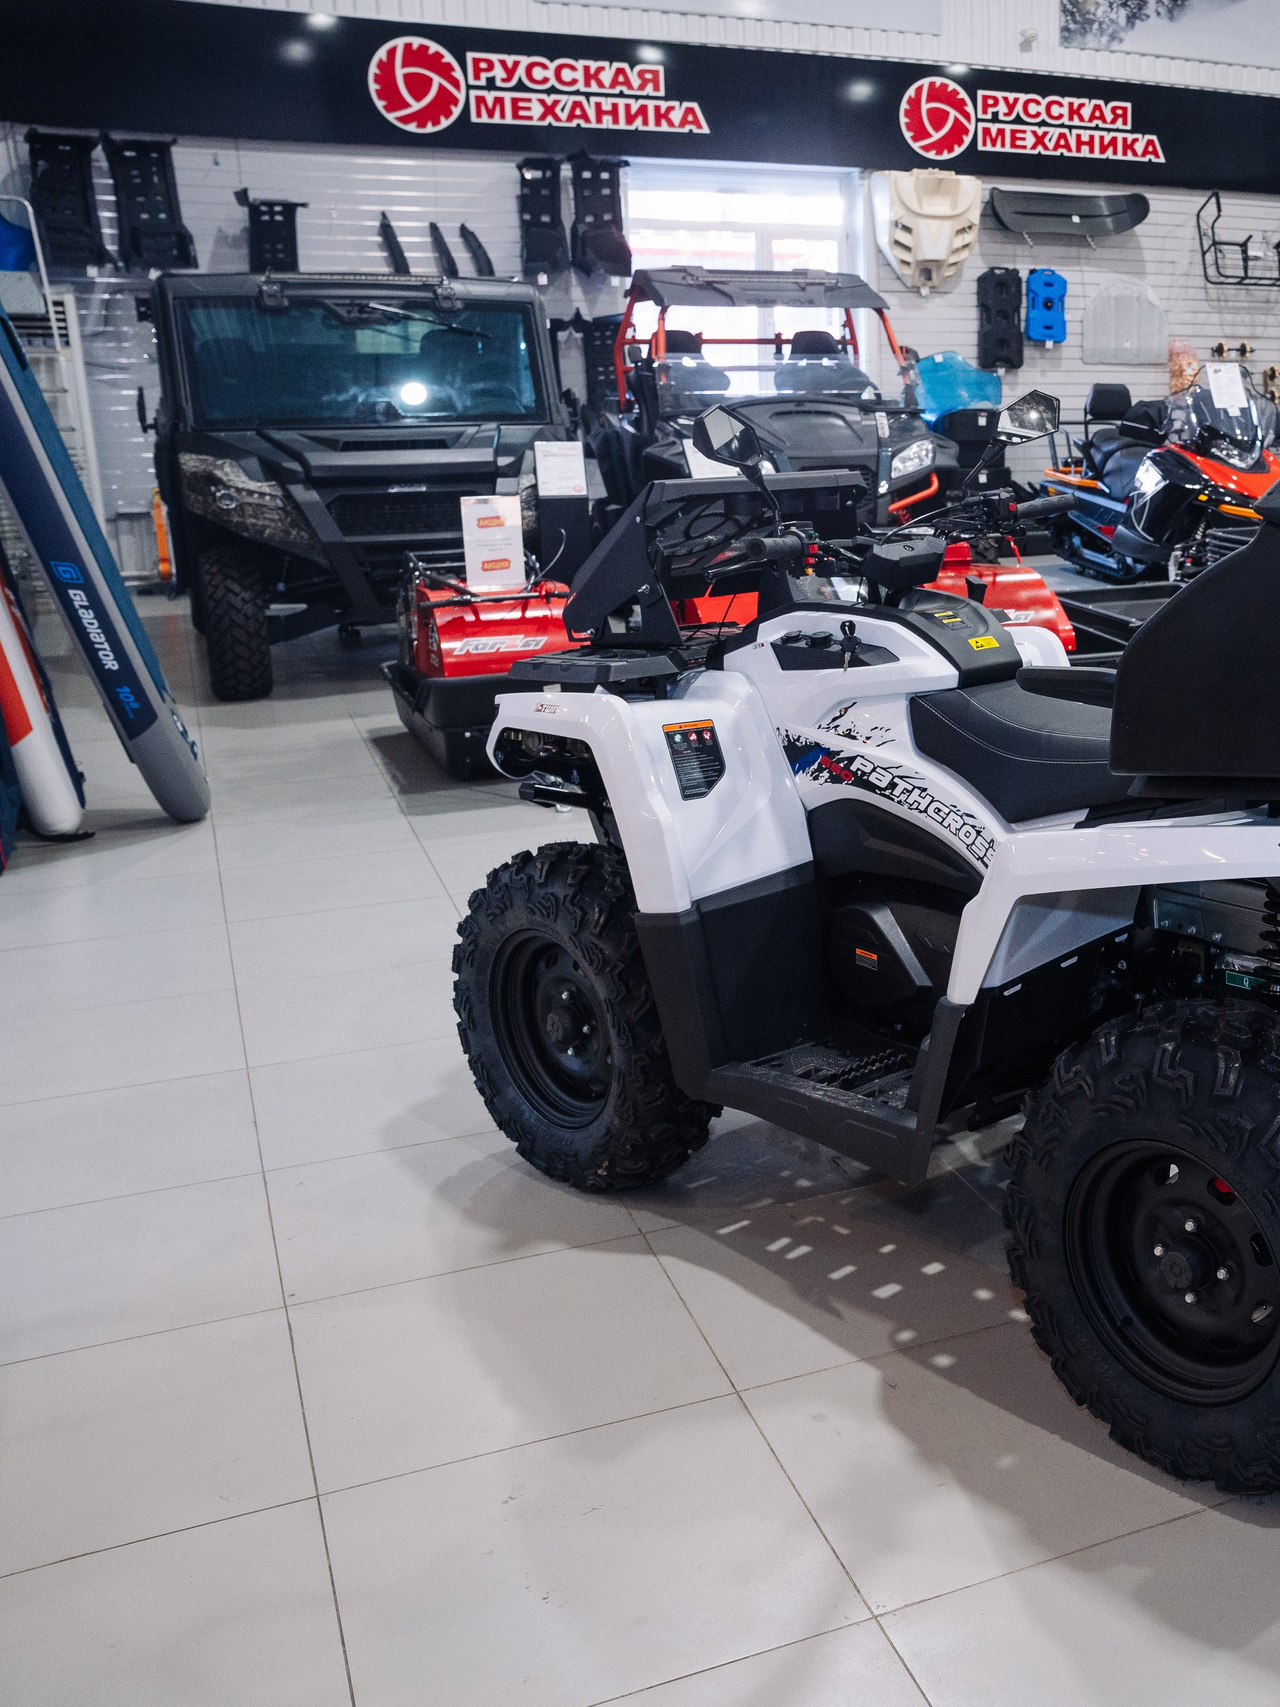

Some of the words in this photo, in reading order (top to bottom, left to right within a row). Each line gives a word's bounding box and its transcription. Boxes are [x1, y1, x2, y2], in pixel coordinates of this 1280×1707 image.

[469, 55, 662, 94] РУССКАЯ
[472, 93, 706, 131] МЕХАНИКА
[979, 92, 1130, 128] РУССКАЯ
[979, 125, 1163, 161] МЕХАНИКА
